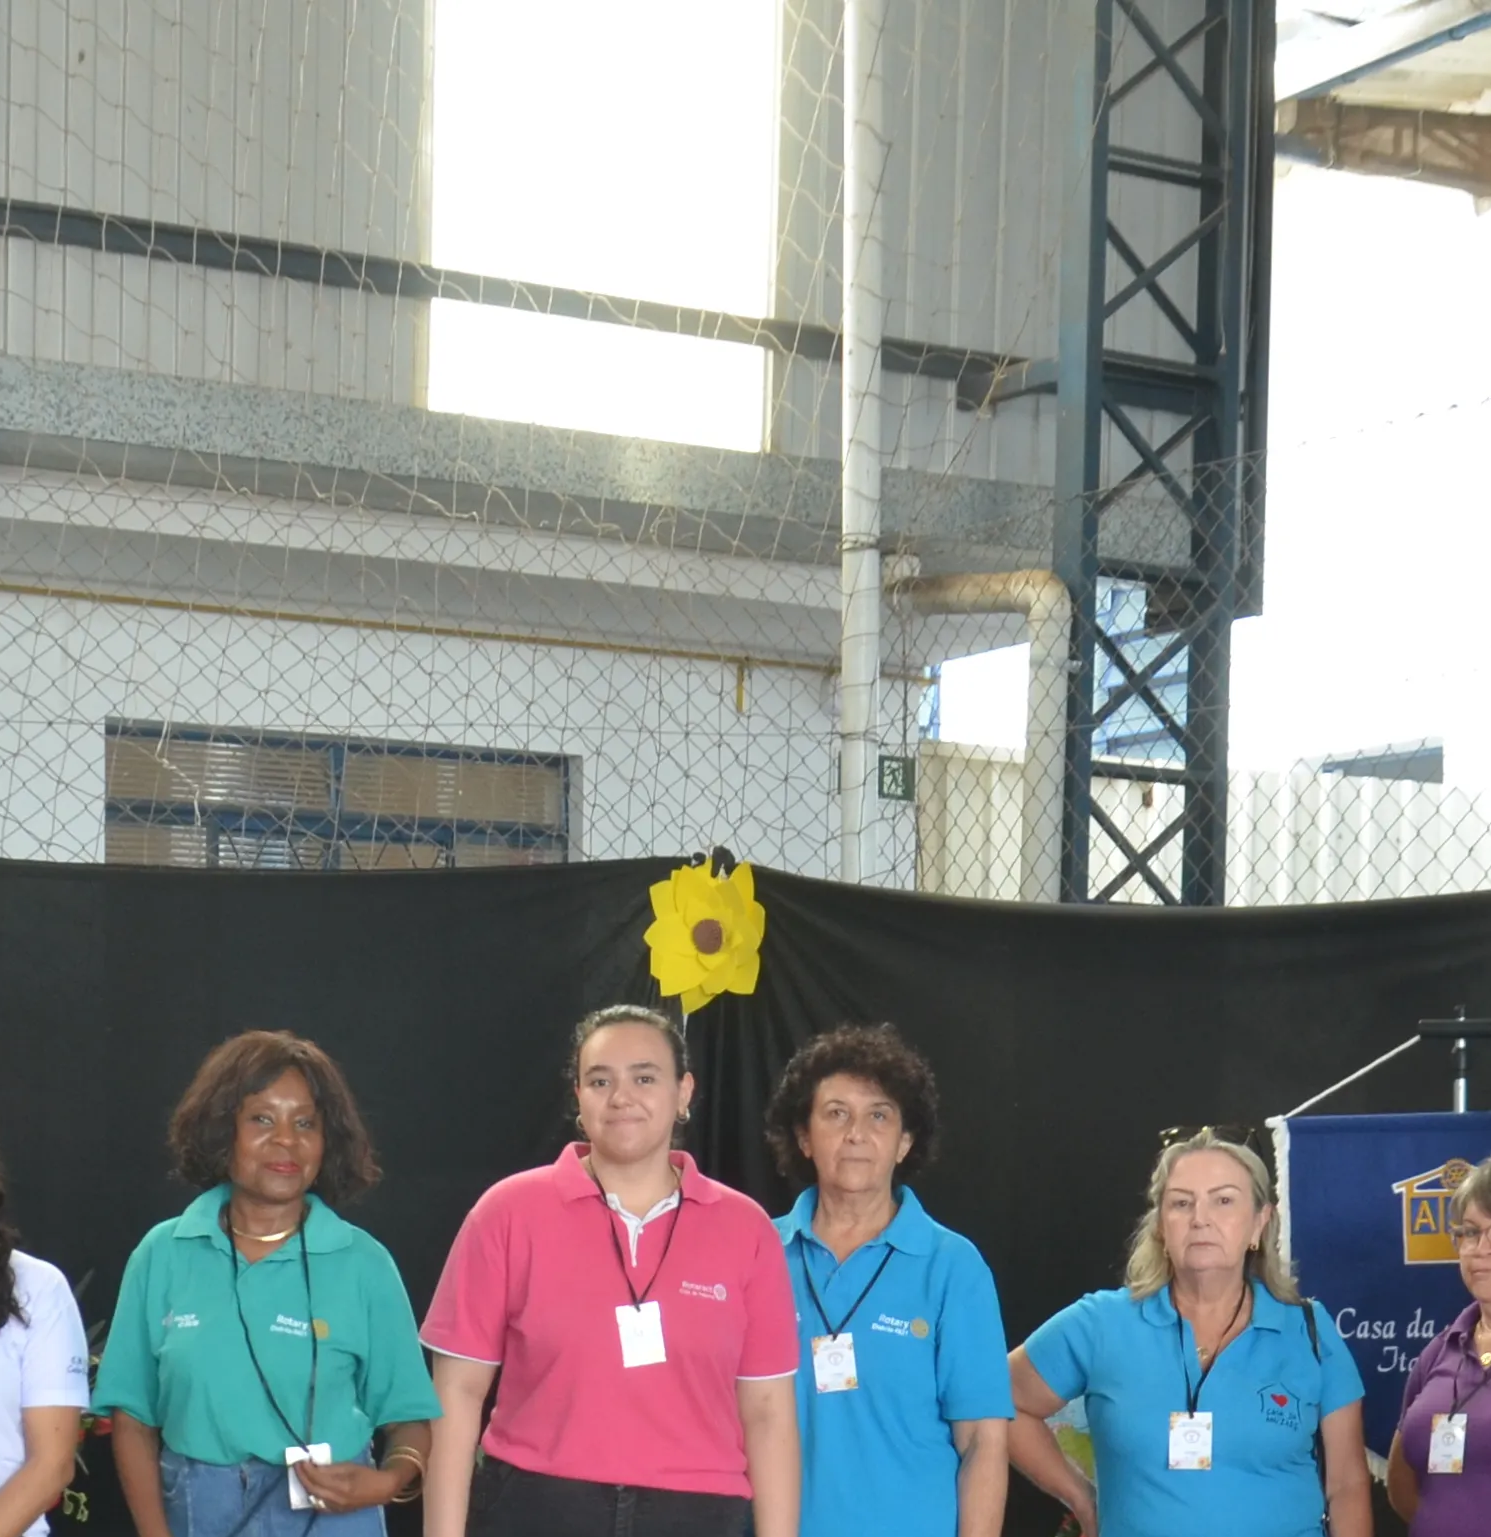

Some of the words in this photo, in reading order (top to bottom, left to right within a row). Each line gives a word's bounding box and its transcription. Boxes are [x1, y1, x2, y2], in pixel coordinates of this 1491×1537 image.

[276, 1314, 308, 1331] Rotary
[879, 1313, 909, 1331] Rotary
[1336, 1307, 1396, 1339] Casa
[1406, 1306, 1435, 1338] da
